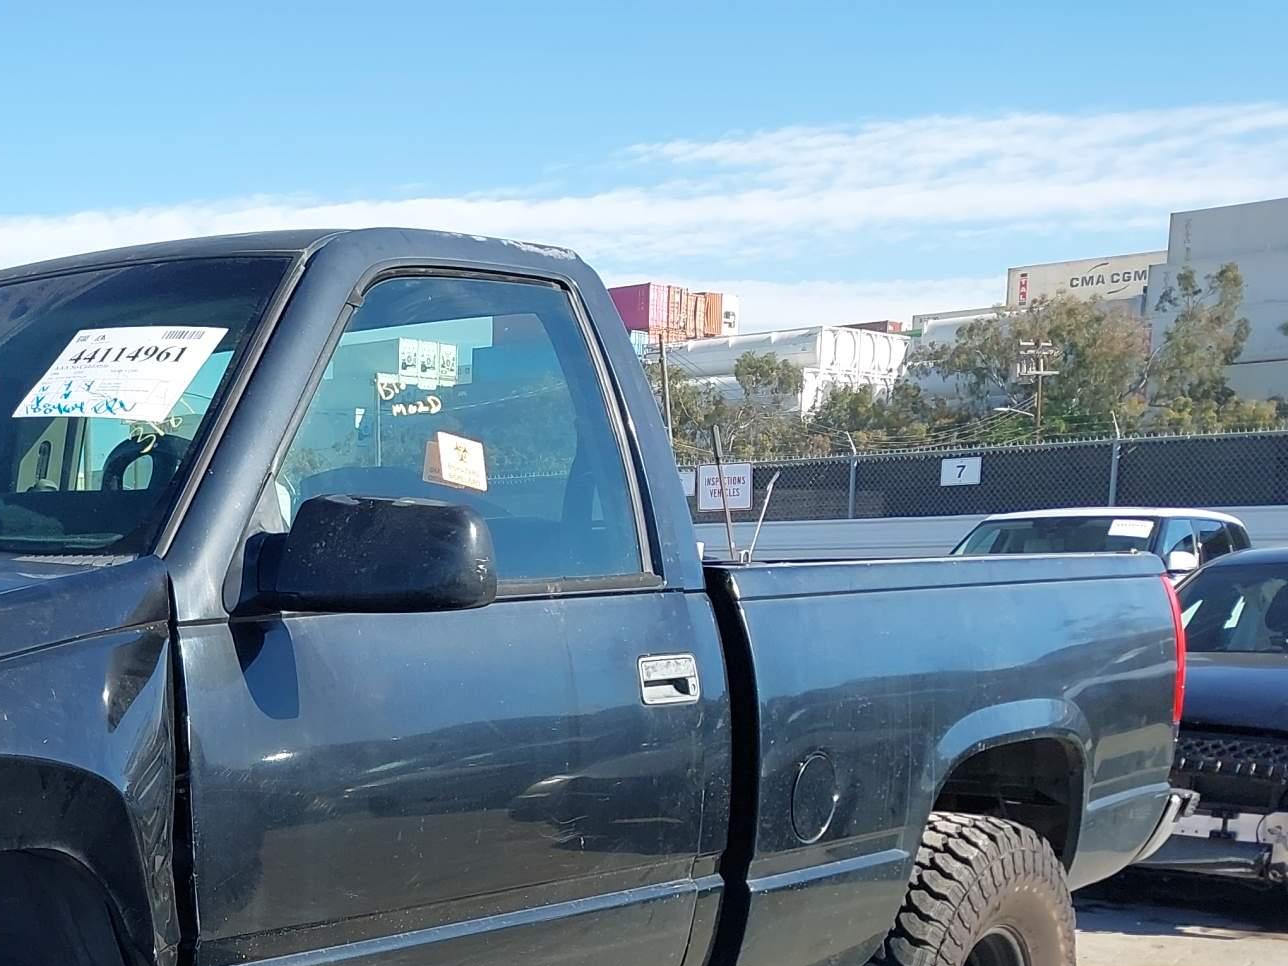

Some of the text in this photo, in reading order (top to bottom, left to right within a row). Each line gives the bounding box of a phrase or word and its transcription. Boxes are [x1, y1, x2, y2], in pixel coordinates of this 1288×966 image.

[1070, 269, 1147, 288] CMA CGM
[69, 345, 188, 364] 44114961
[955, 464, 966, 479] 7
[704, 476, 746, 487] INSPTIONS
[710, 488, 741, 498] VEHLES
